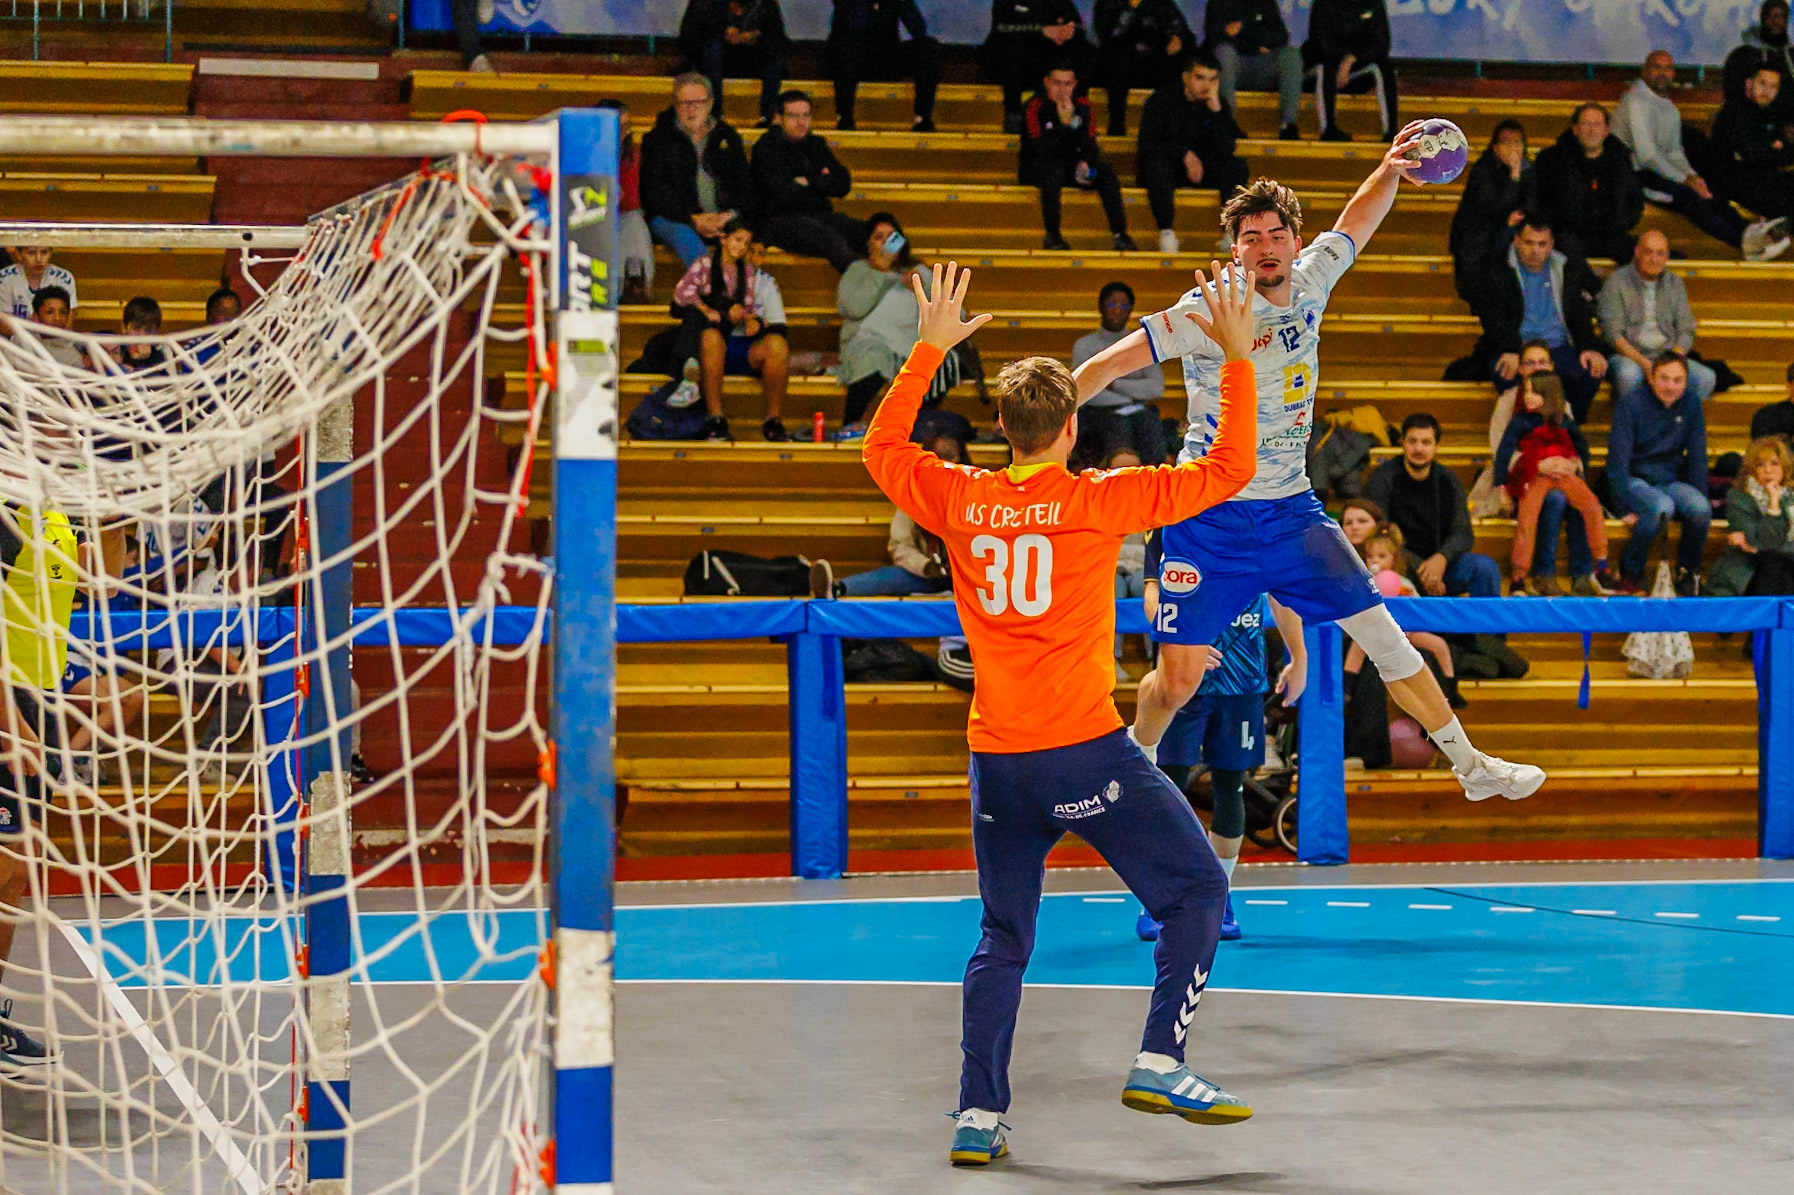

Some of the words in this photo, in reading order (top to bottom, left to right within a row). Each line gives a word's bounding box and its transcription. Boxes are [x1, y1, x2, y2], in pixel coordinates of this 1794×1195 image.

[1278, 325, 1301, 353] 12
[965, 502, 987, 526] US
[970, 533, 1054, 618] 30
[1157, 602, 1179, 634] 12
[1240, 720, 1255, 751] 4
[1053, 794, 1102, 814] ADIM
